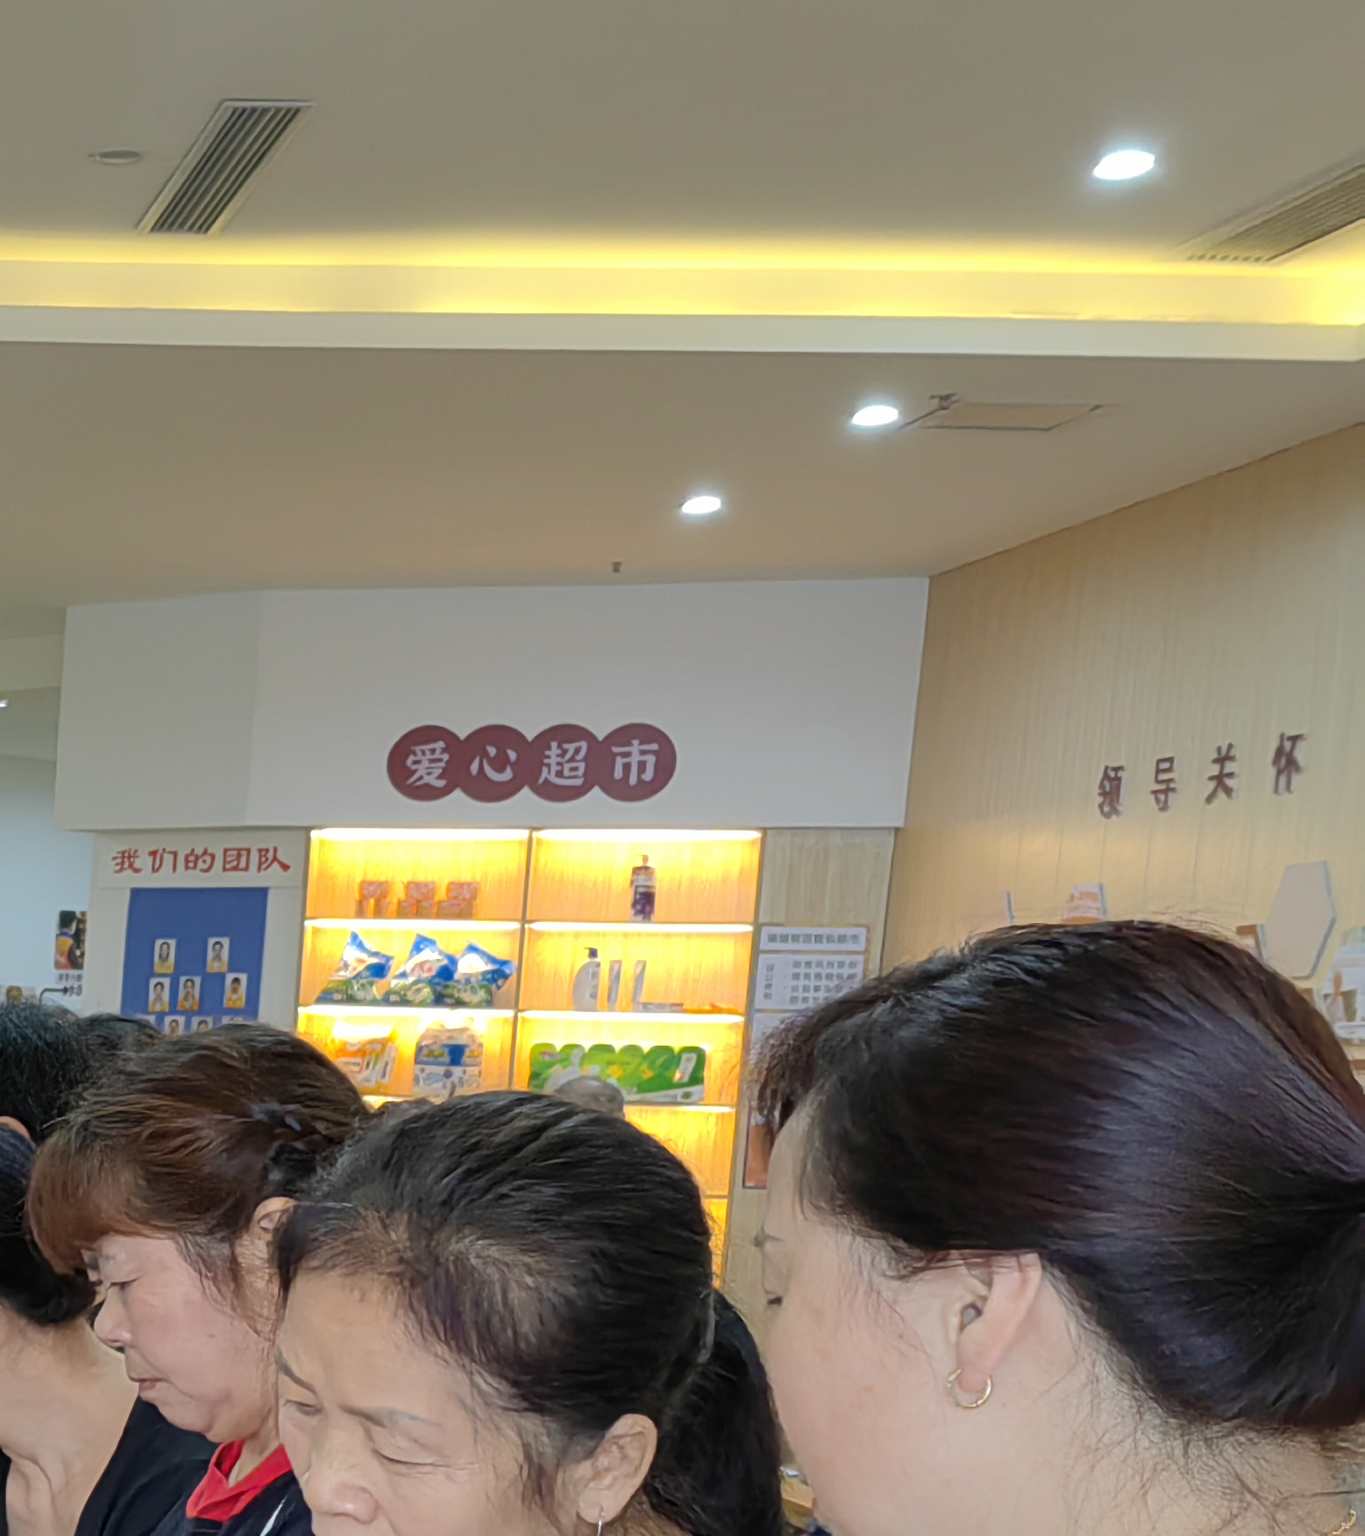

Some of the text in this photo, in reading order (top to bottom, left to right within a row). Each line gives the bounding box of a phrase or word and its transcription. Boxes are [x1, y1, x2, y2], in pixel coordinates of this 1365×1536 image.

[404, 739, 660, 789] 爱心超市
[1098, 733, 1305, 819] 领导关怀
[111, 846, 291, 875] 我们的团队
